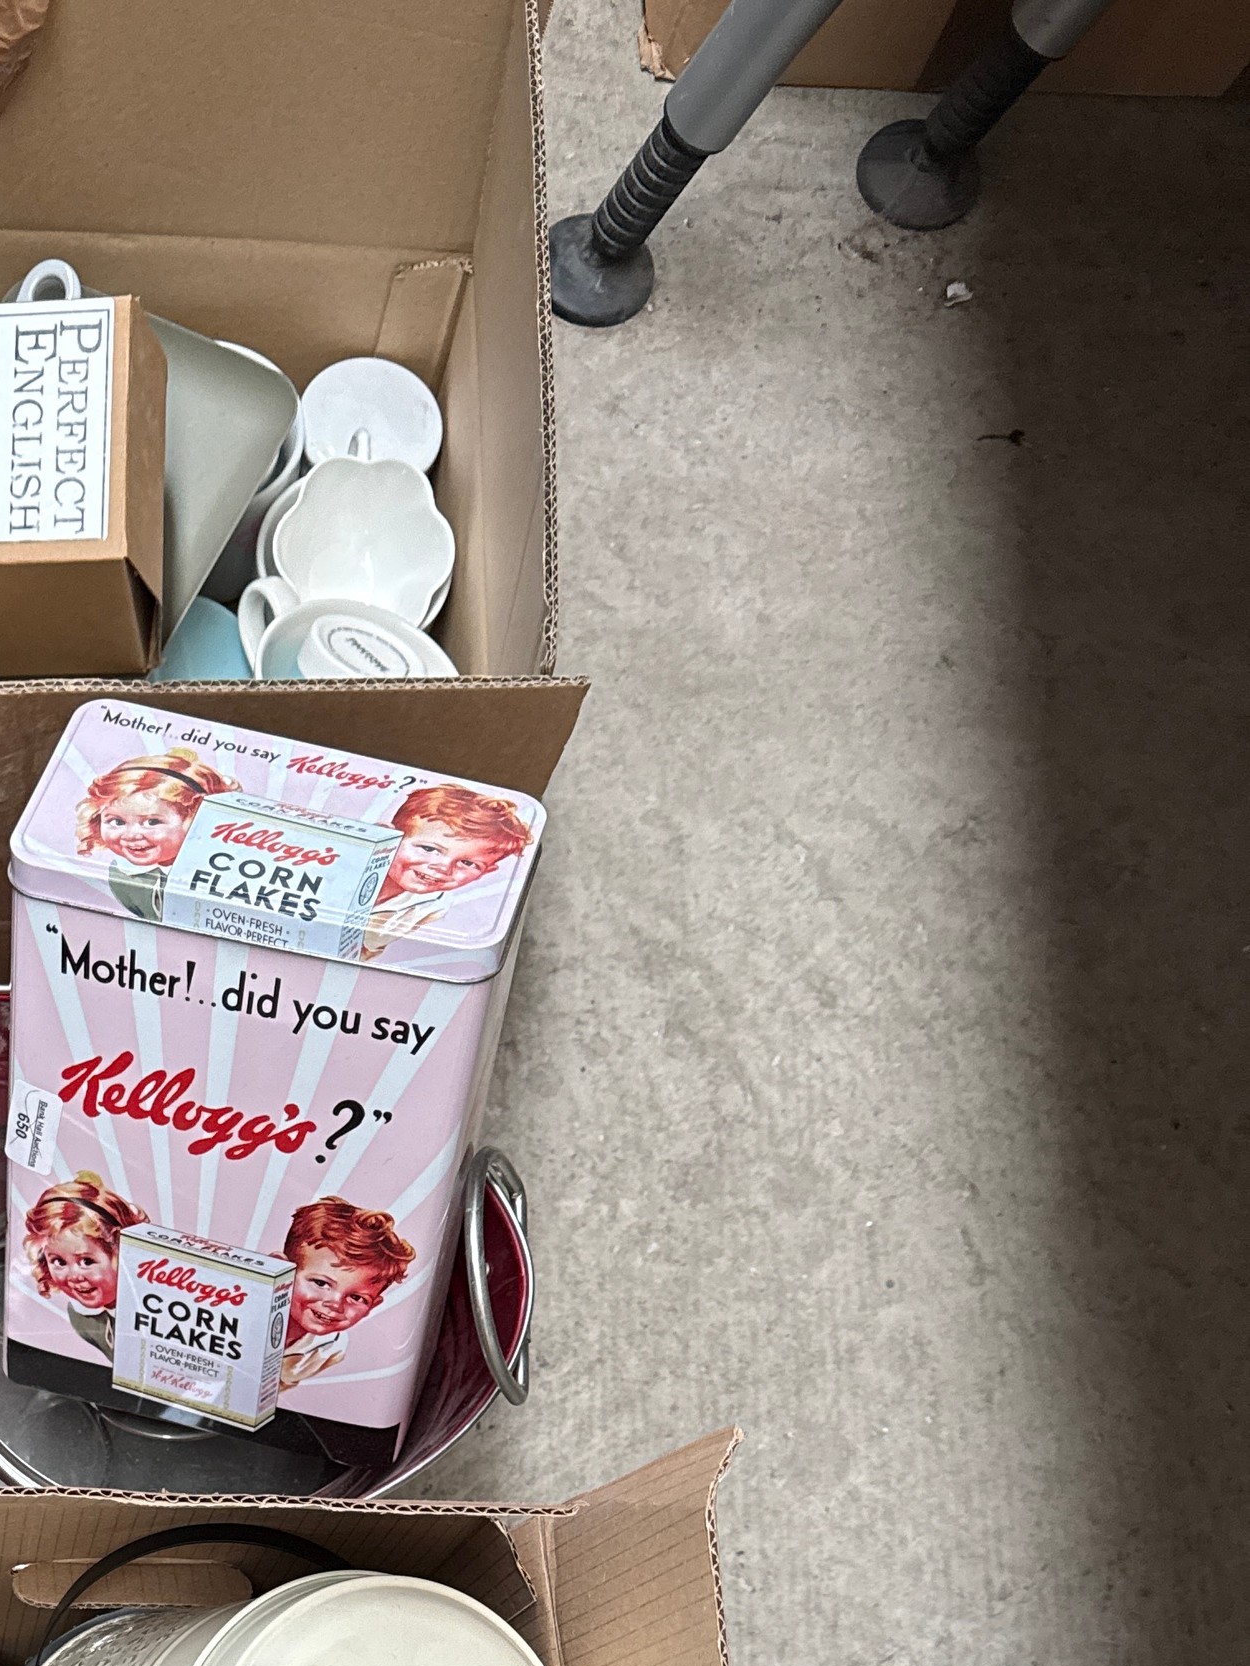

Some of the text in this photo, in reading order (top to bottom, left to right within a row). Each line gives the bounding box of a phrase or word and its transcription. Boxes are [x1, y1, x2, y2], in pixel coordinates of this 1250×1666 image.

[8, 323, 58, 535] ENGLISH
[53, 318, 103, 535] PERFECT
[214, 739, 248, 755] you
[250, 747, 282, 764] say
[210, 821, 342, 866] Kellogg's
[189, 869, 322, 922] FLAKES
[209, 852, 323, 896] CORN
[292, 997, 363, 1036] you
[370, 1013, 436, 1056] say
[15, 1112, 30, 1139] 650
[30, 1100, 48, 1168] Bank Hall Auctions
[136, 1258, 248, 1307] Kellogg's
[134, 1311, 243, 1361] FLAKES
[142, 1293, 239, 1338] CORN
